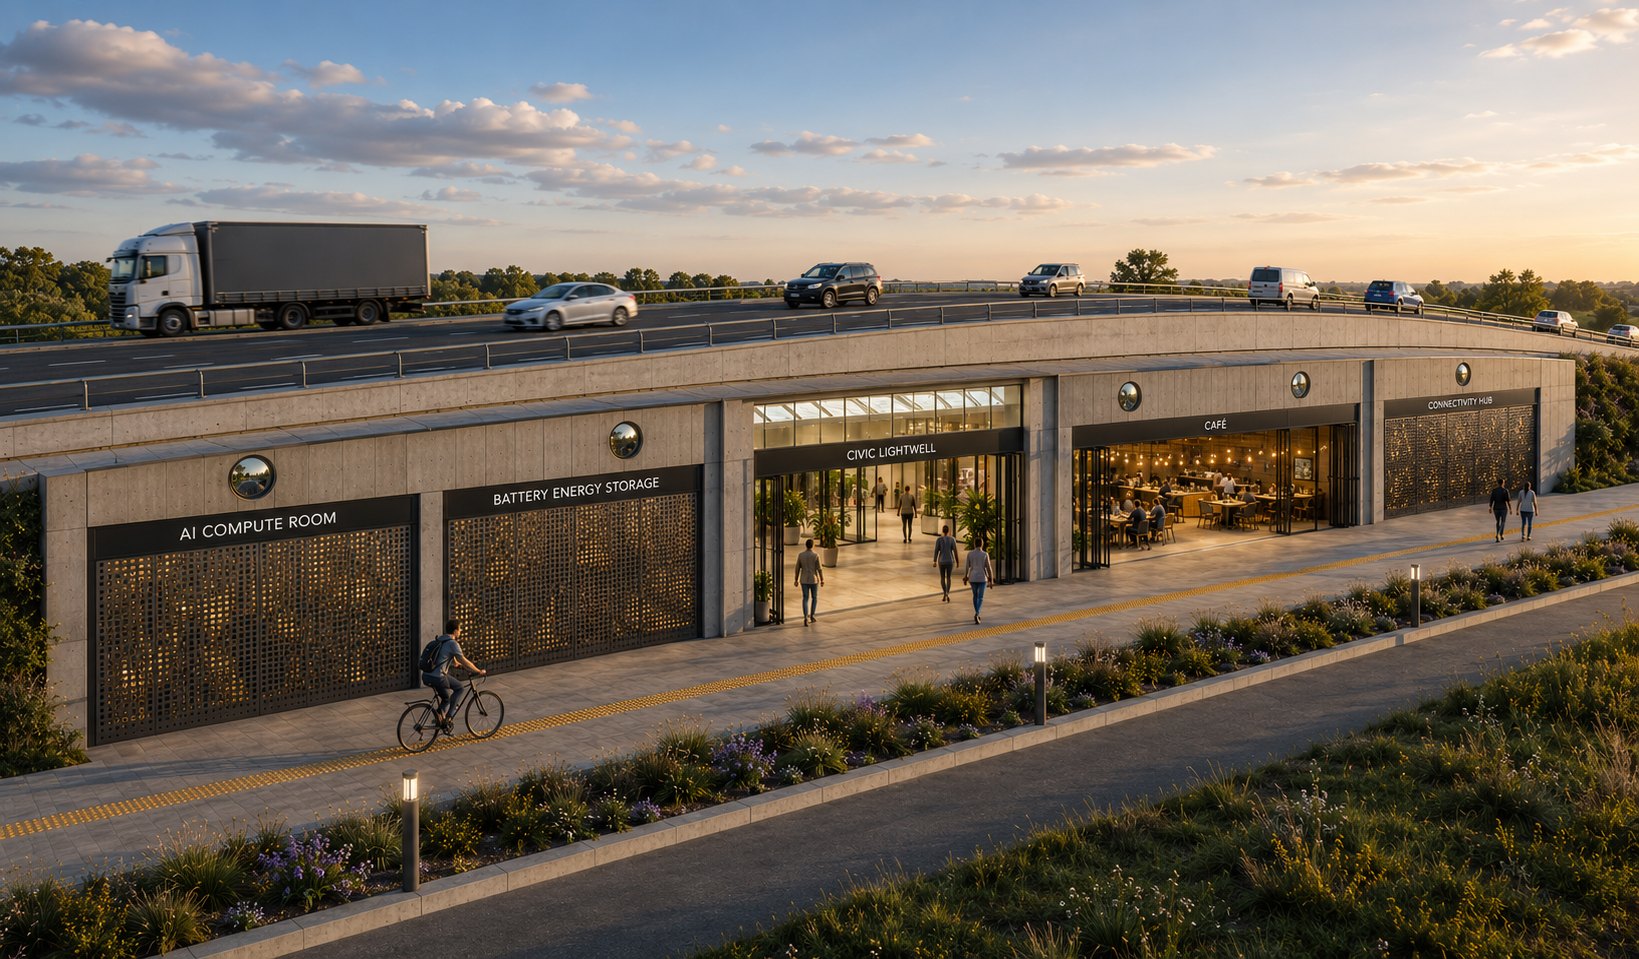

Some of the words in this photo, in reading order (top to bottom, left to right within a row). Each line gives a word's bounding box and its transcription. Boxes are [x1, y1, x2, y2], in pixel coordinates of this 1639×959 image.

[1427, 397, 1478, 410] CONNECTIVITY
[1478, 396, 1493, 405] HUB
[1204, 418, 1227, 431] CAFÉ
[846, 447, 876, 461] CIVIC
[879, 443, 937, 458] LIGHTWELL
[493, 488, 549, 506] BATTERY
[552, 482, 602, 499] ENERGY
[605, 476, 660, 494] STORAGE
[179, 526, 196, 541] AI
[202, 517, 283, 538] COMPUTE
[288, 511, 336, 529] ROOM
